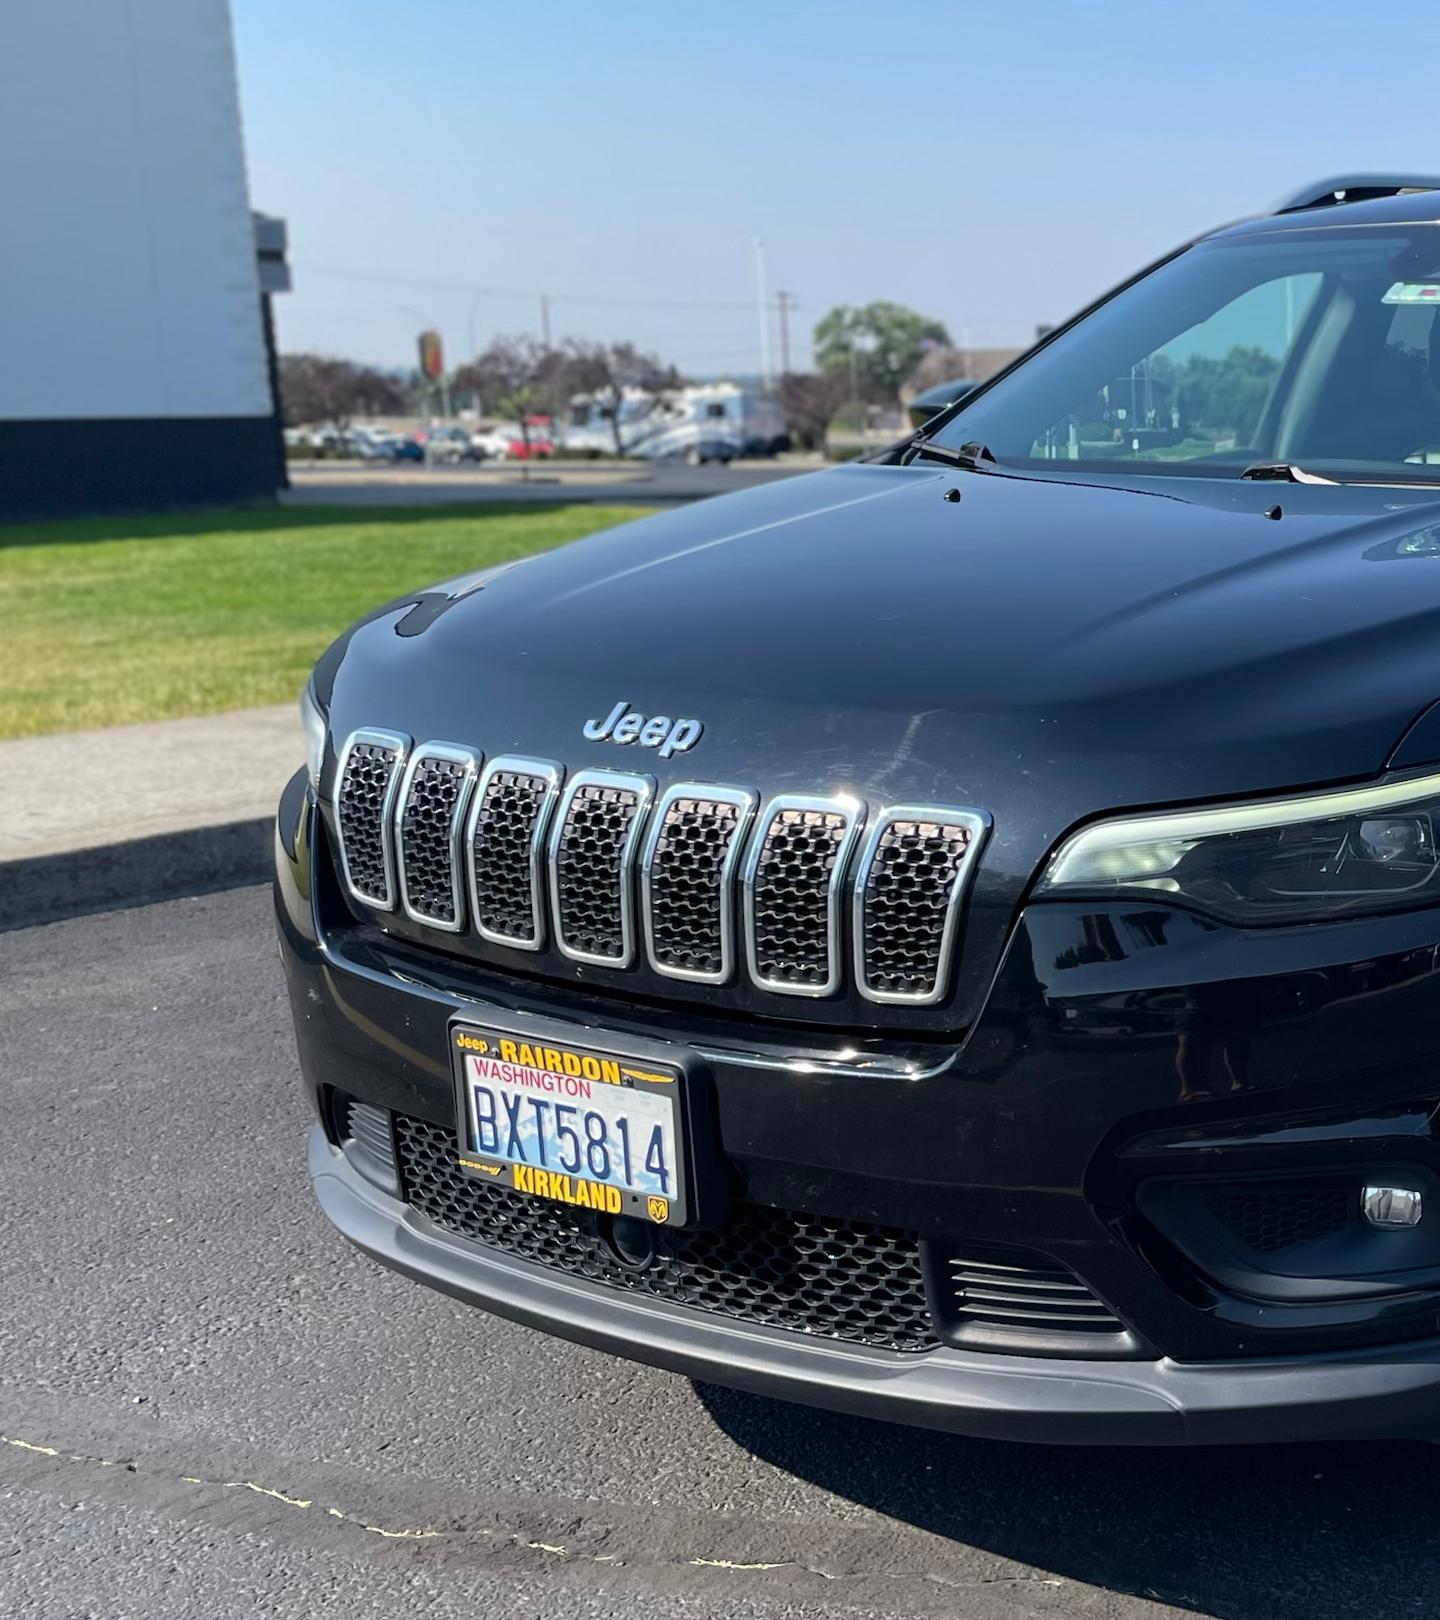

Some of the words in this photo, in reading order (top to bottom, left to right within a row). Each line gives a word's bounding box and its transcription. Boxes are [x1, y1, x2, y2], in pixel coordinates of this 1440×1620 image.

[583, 701, 703, 759] Jeep
[456, 1032, 489, 1055] Jeep
[500, 1039, 622, 1086] RAIRDON
[474, 1058, 592, 1100] WASHINGTON
[474, 1085, 669, 1194] BXT5814
[513, 1164, 623, 1215] KIRKLAND
